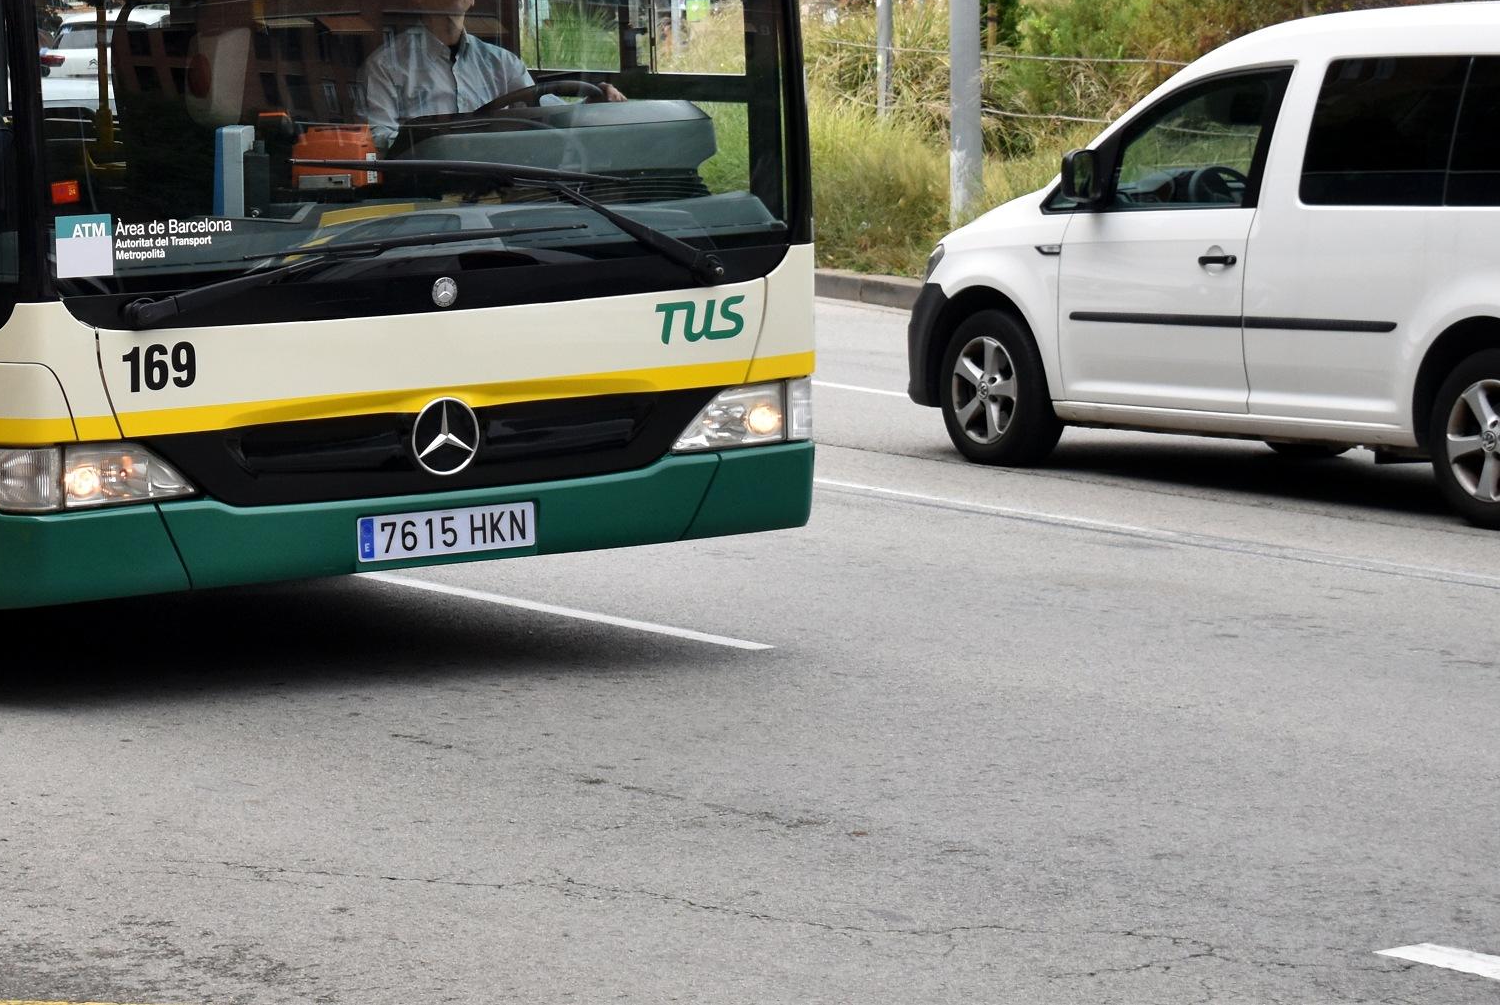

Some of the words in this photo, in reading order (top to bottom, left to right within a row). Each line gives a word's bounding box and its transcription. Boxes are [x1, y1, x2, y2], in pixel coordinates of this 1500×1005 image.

[72, 223, 106, 238] ATM
[115, 218, 145, 236] Àrea
[148, 220, 165, 235] de
[168, 218, 232, 234] Barcelona
[115, 237, 153, 248] Autoritat
[155, 237, 168, 246] del
[171, 235, 212, 247] Transport
[115, 248, 165, 261] Metropolità
[655, 295, 745, 345] TUS
[122, 341, 197, 393] 169
[380, 516, 458, 554] 7615
[470, 509, 526, 545] HKN
[364, 542, 371, 553] E
